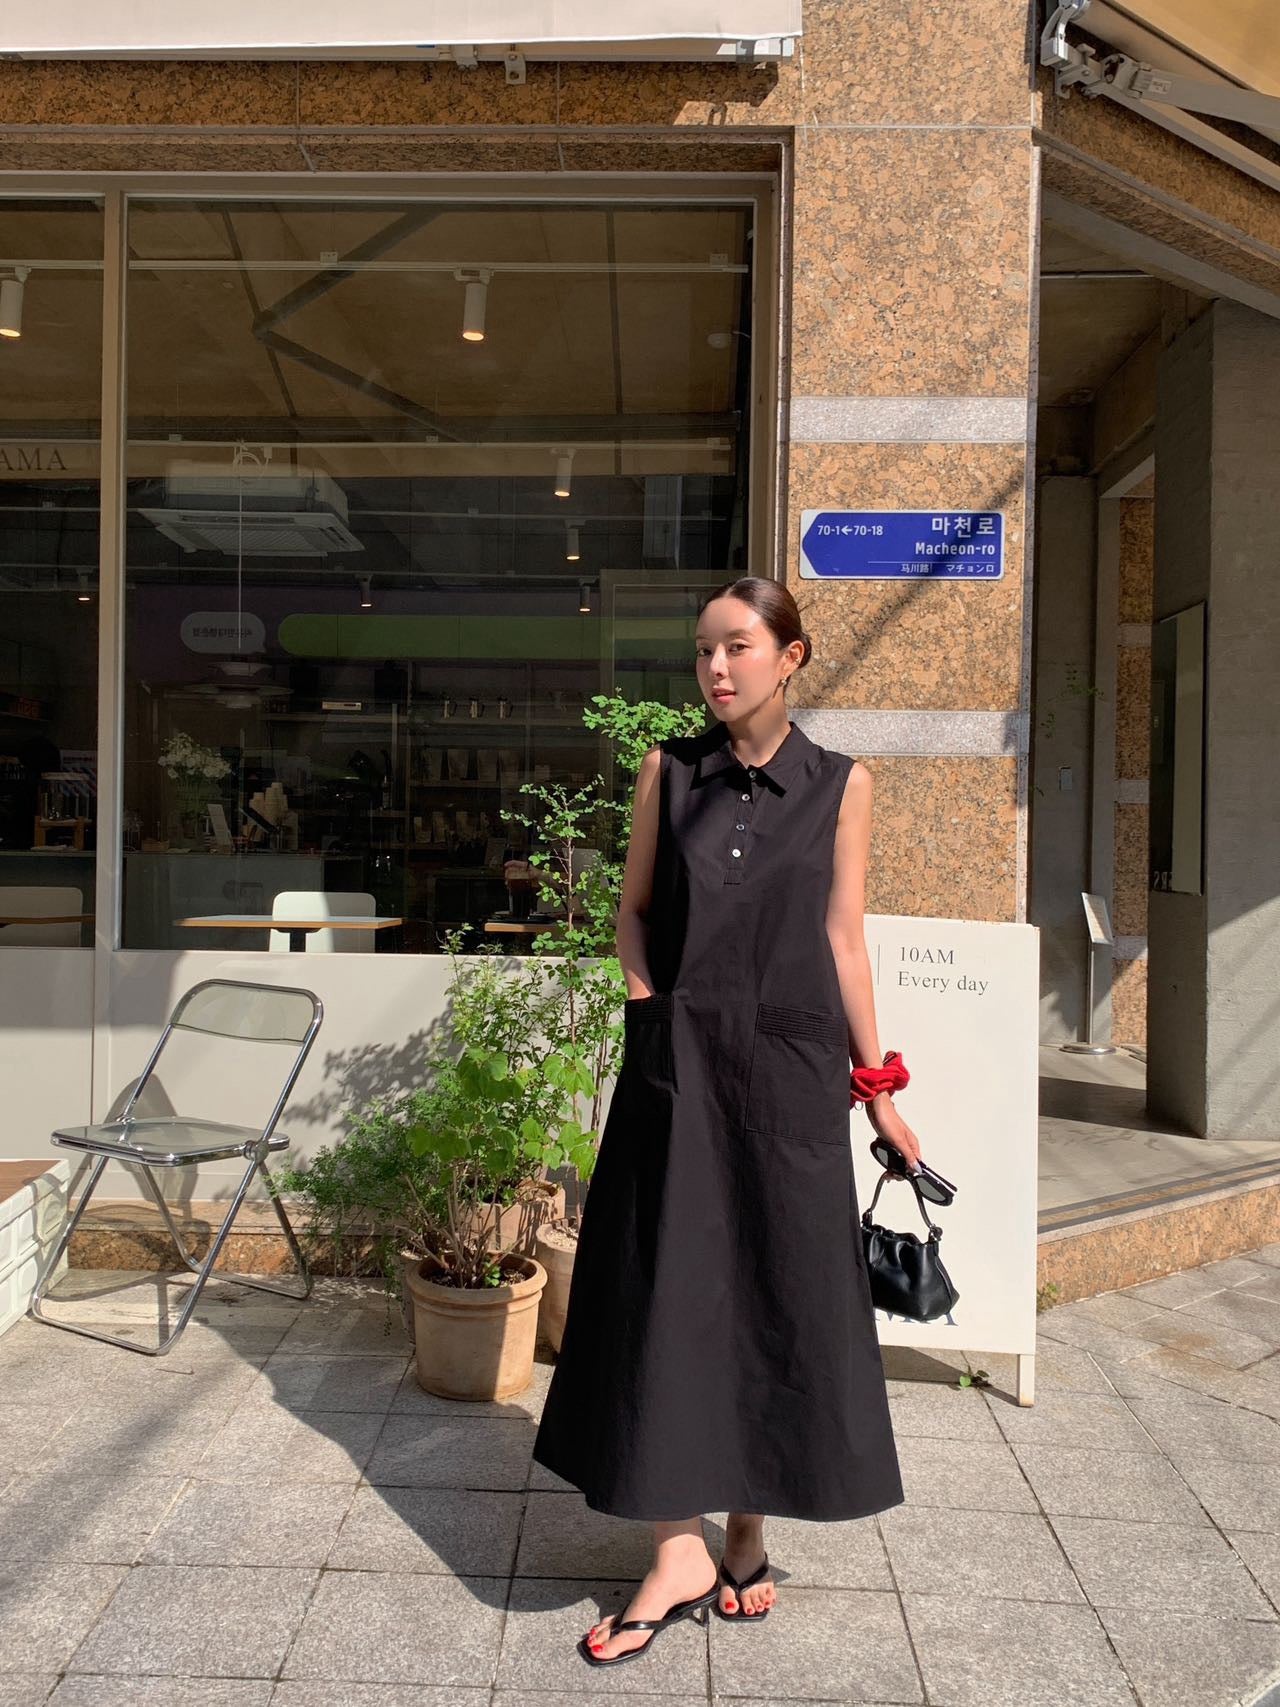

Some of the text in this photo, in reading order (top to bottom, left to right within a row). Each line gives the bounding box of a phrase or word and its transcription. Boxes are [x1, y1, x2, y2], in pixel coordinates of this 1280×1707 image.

[817, 525, 884, 536] 70-1 70-18
[931, 516, 996, 538] 마천로
[915, 541, 996, 556] Macheon-ro
[945, 563, 994, 573] マチョンロ
[899, 946, 956, 965] 10AM
[898, 971, 989, 996] Every day
